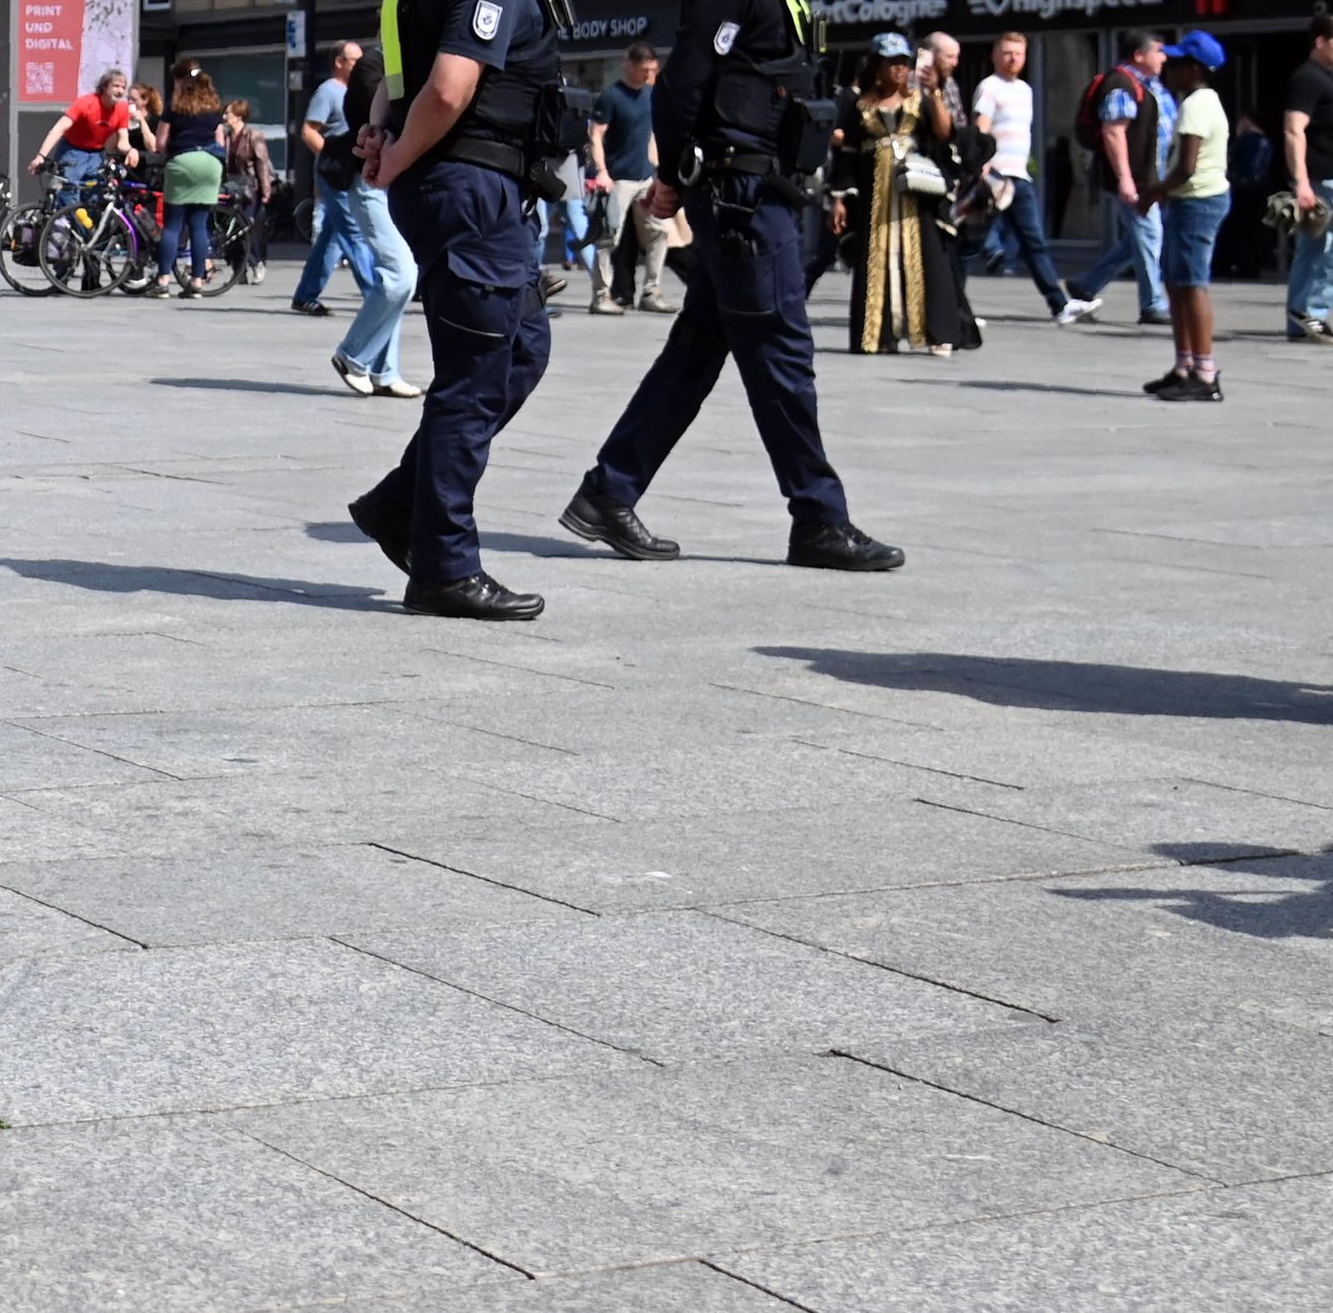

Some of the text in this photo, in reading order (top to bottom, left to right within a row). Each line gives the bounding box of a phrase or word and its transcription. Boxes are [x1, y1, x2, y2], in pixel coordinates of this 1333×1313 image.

[25, 4, 63, 17] PRINT
[25, 22, 53, 34] UND
[573, 20, 607, 40] BODY
[610, 17, 648, 37] SHOP
[25, 39, 74, 51] DIGITAL
